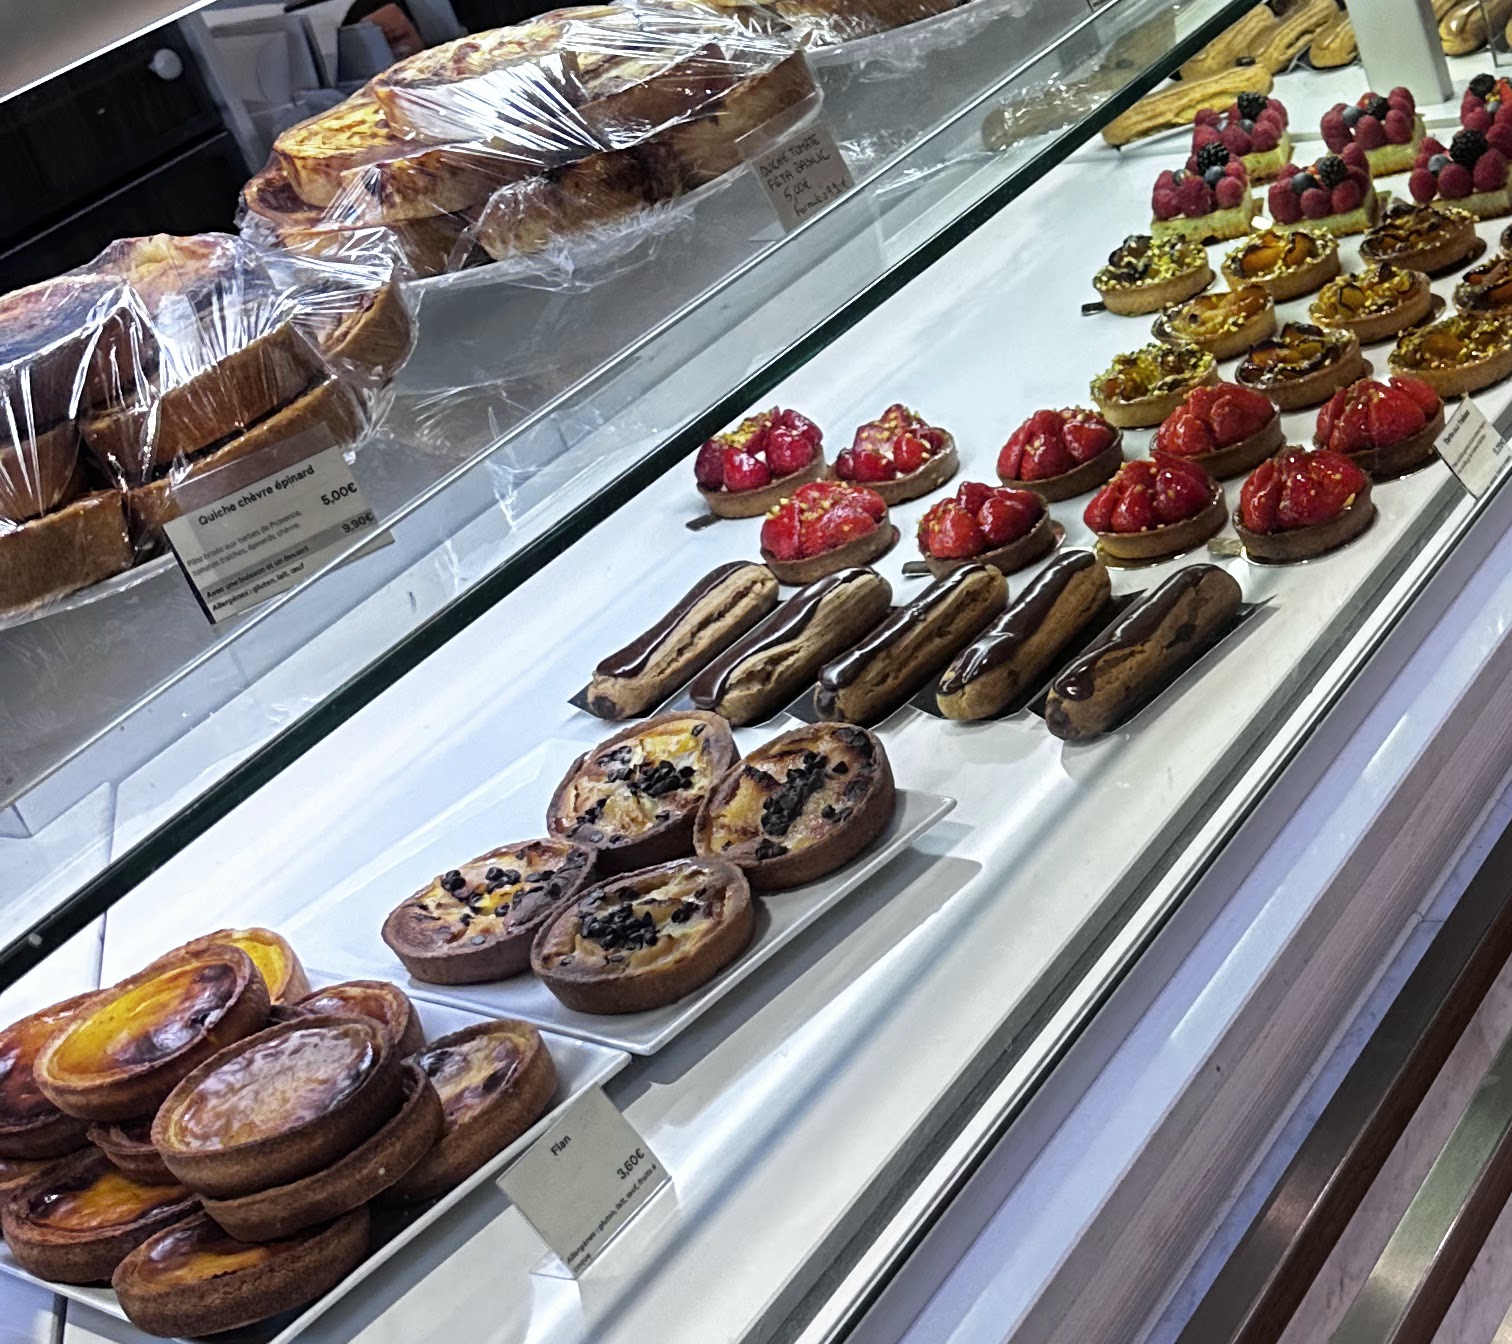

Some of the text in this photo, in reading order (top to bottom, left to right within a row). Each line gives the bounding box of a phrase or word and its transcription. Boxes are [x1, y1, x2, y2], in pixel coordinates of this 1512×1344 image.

[198, 465, 314, 525] Quiche chèvre épinard
[321, 483, 357, 505] 5,00€
[342, 512, 374, 533] 9,90€
[550, 1136, 571, 1156] Flan
[617, 1148, 644, 1180] 3,60€
